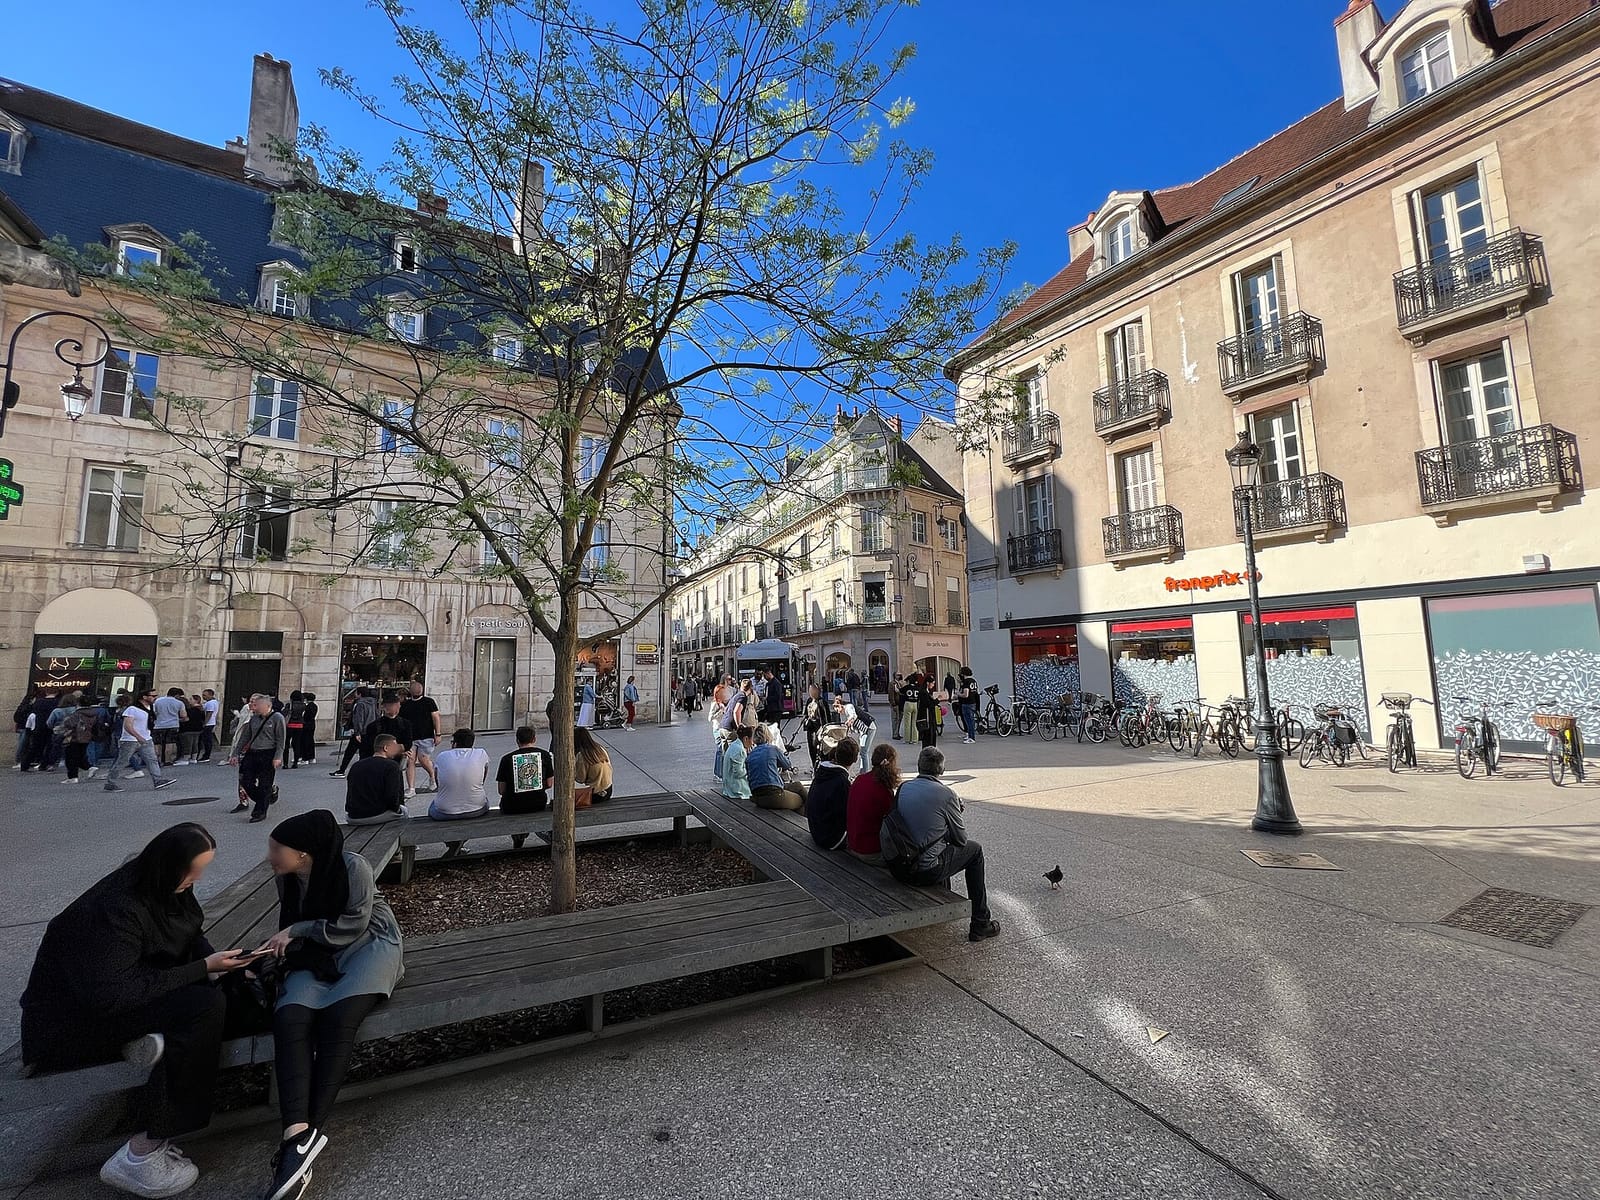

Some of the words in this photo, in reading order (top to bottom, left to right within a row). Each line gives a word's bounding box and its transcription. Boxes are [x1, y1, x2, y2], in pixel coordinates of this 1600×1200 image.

[1164, 569, 1241, 591] franprix
[464, 619, 476, 627] Le
[480, 619, 502, 628] petit
[505, 619, 528, 628] Souk
